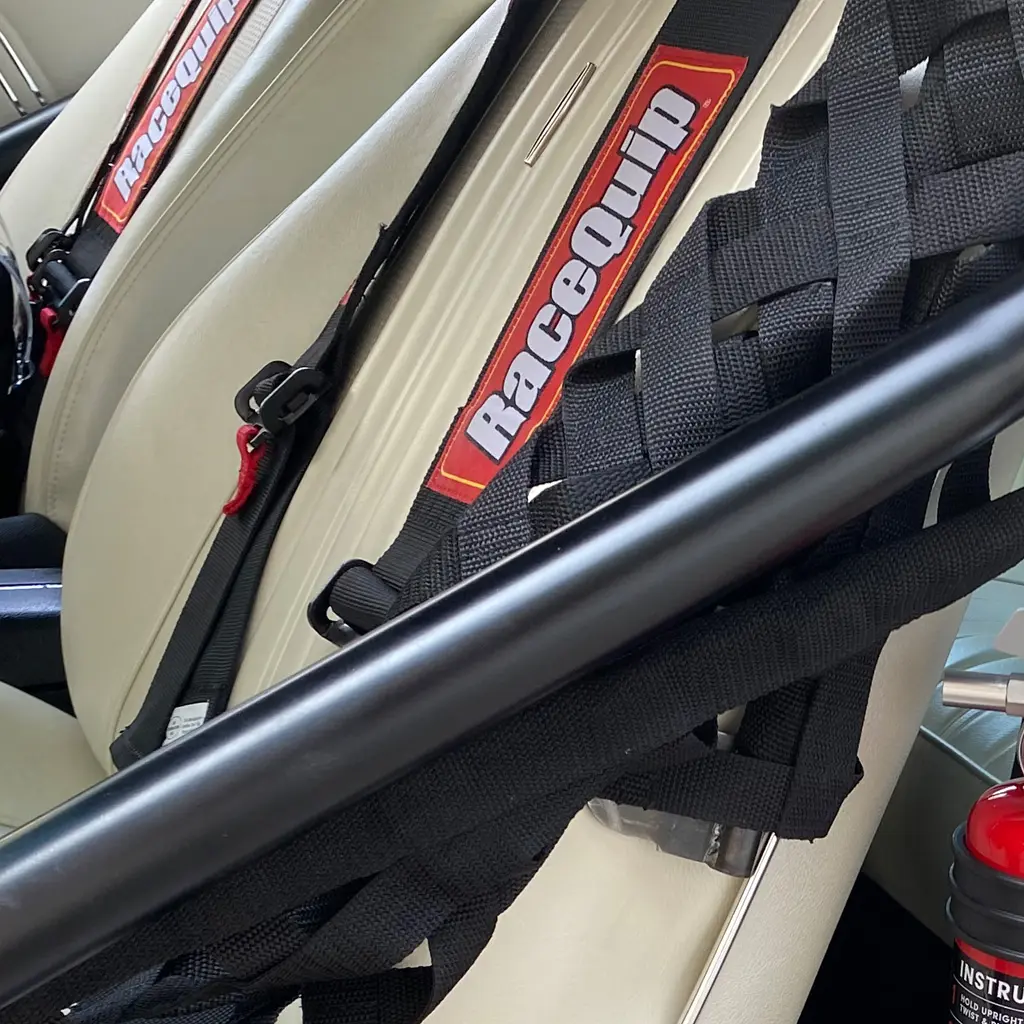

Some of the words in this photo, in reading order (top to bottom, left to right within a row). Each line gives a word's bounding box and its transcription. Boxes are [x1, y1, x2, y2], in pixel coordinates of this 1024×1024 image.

[465, 86, 699, 462] RaceQuip
[960, 994, 979, 1010] HOLD
[960, 1004, 979, 1022] TWIST
